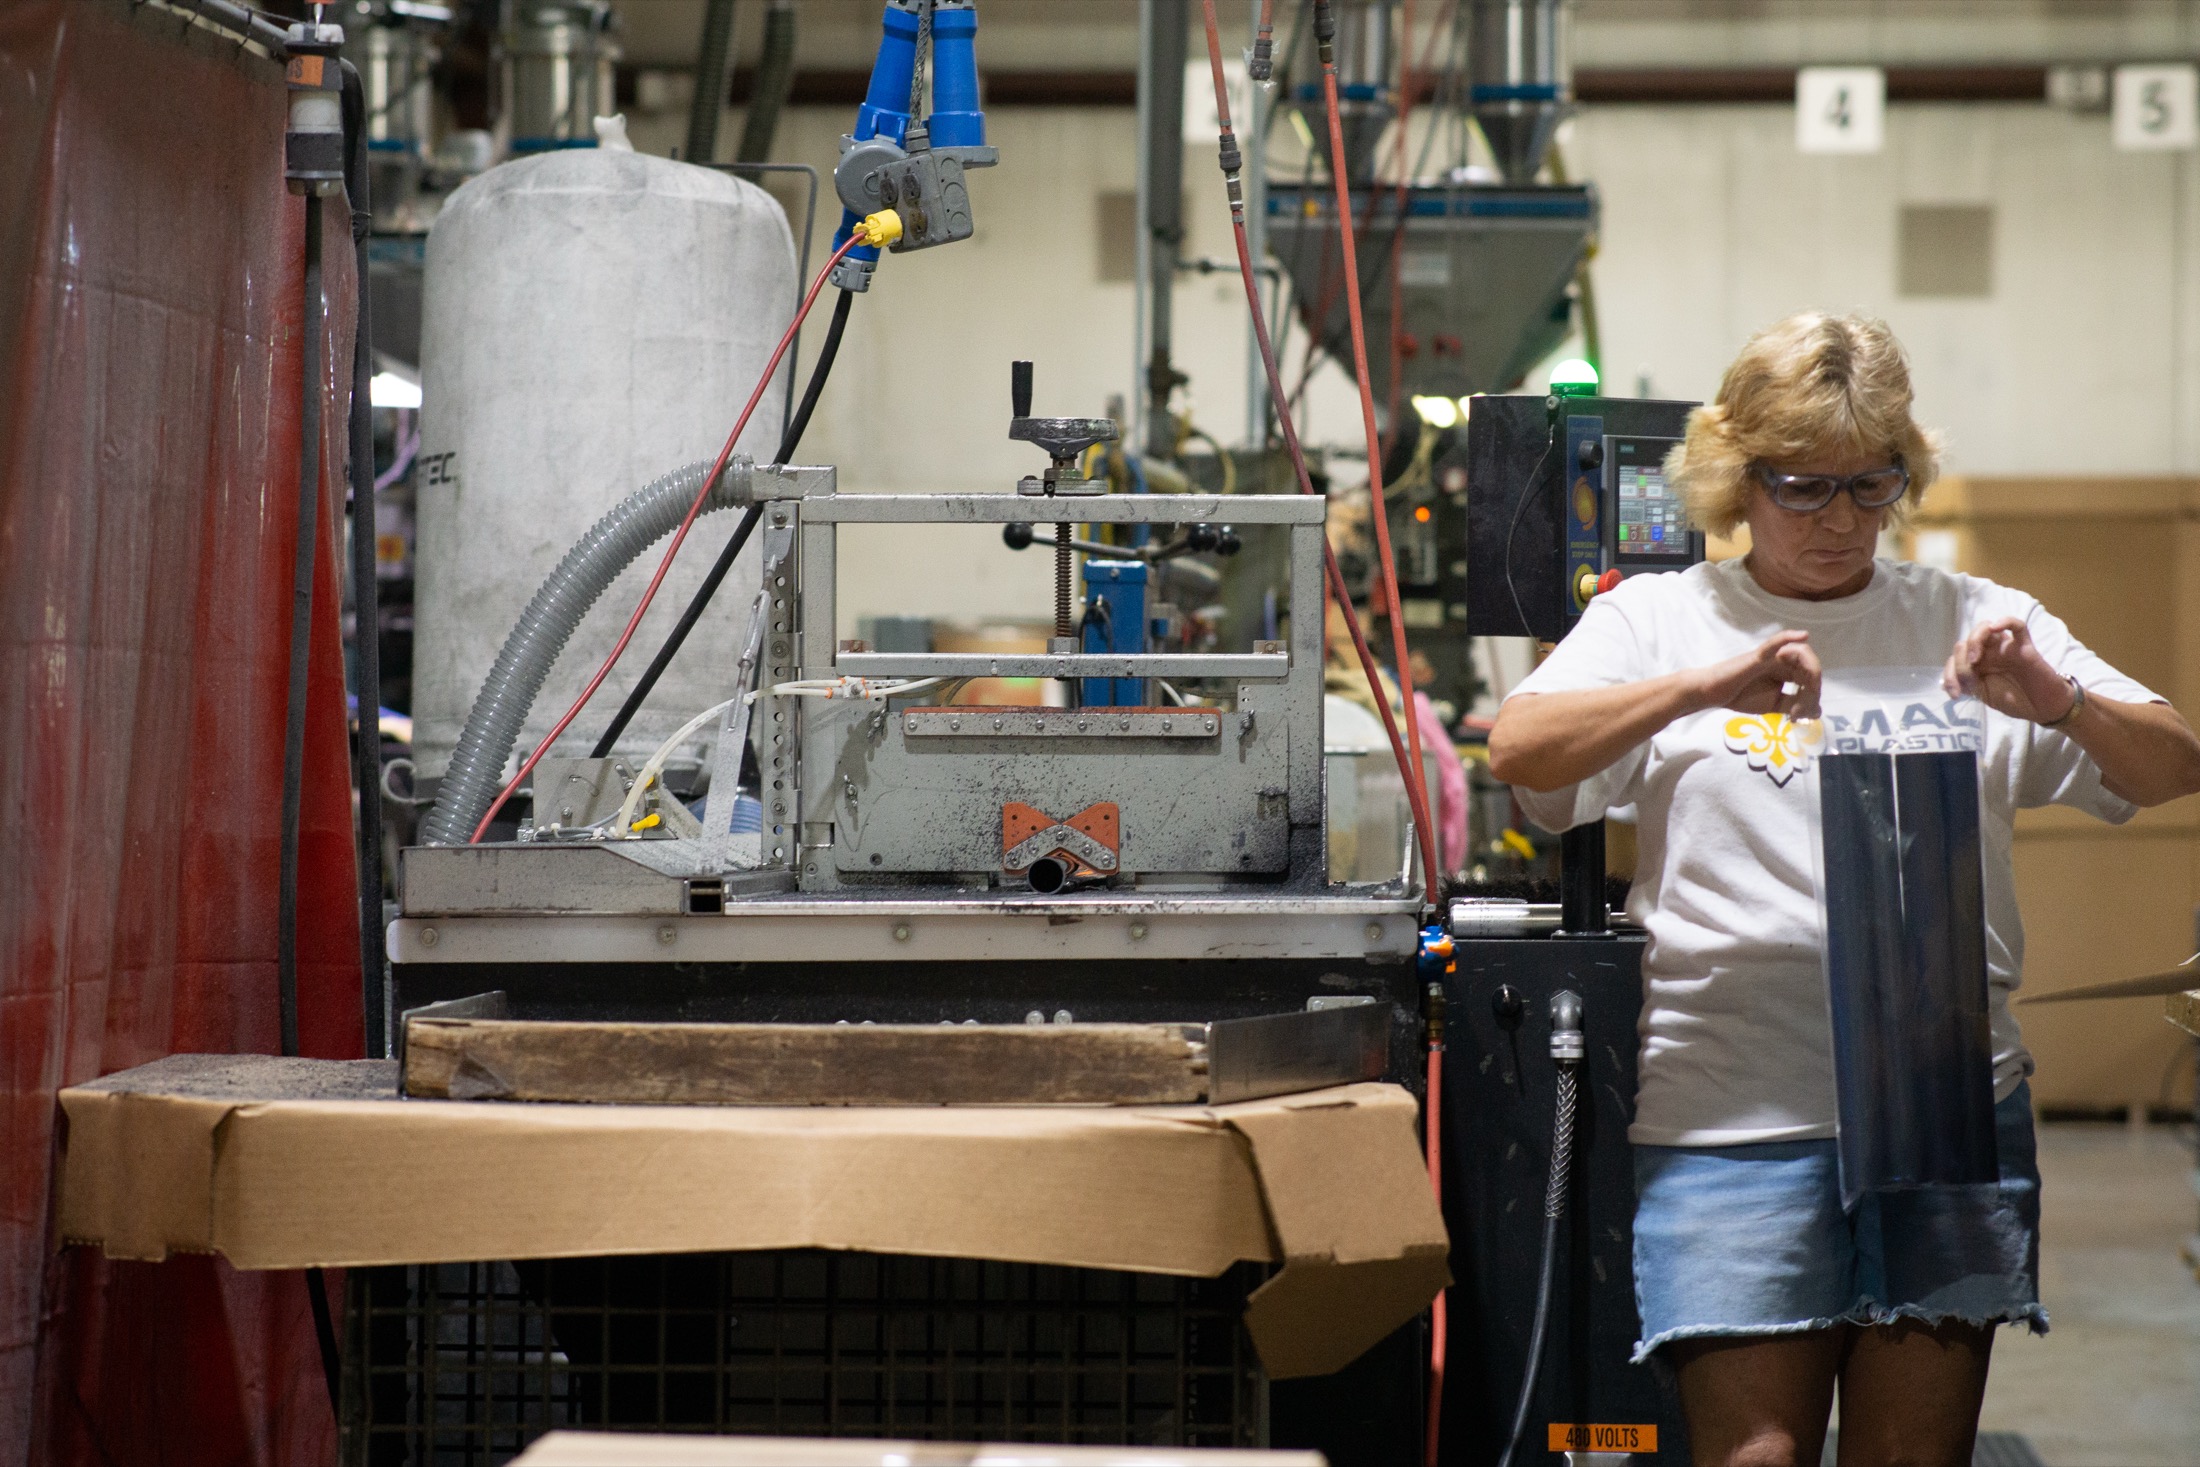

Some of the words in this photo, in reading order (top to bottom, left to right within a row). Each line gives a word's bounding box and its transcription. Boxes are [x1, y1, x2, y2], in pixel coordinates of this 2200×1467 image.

[1824, 82, 1852, 130] 4
[2139, 80, 2171, 134] 5
[1826, 695, 1982, 736] MAC
[1566, 1427, 1591, 1448] 480
[1595, 1427, 1639, 1448] VOLTS
